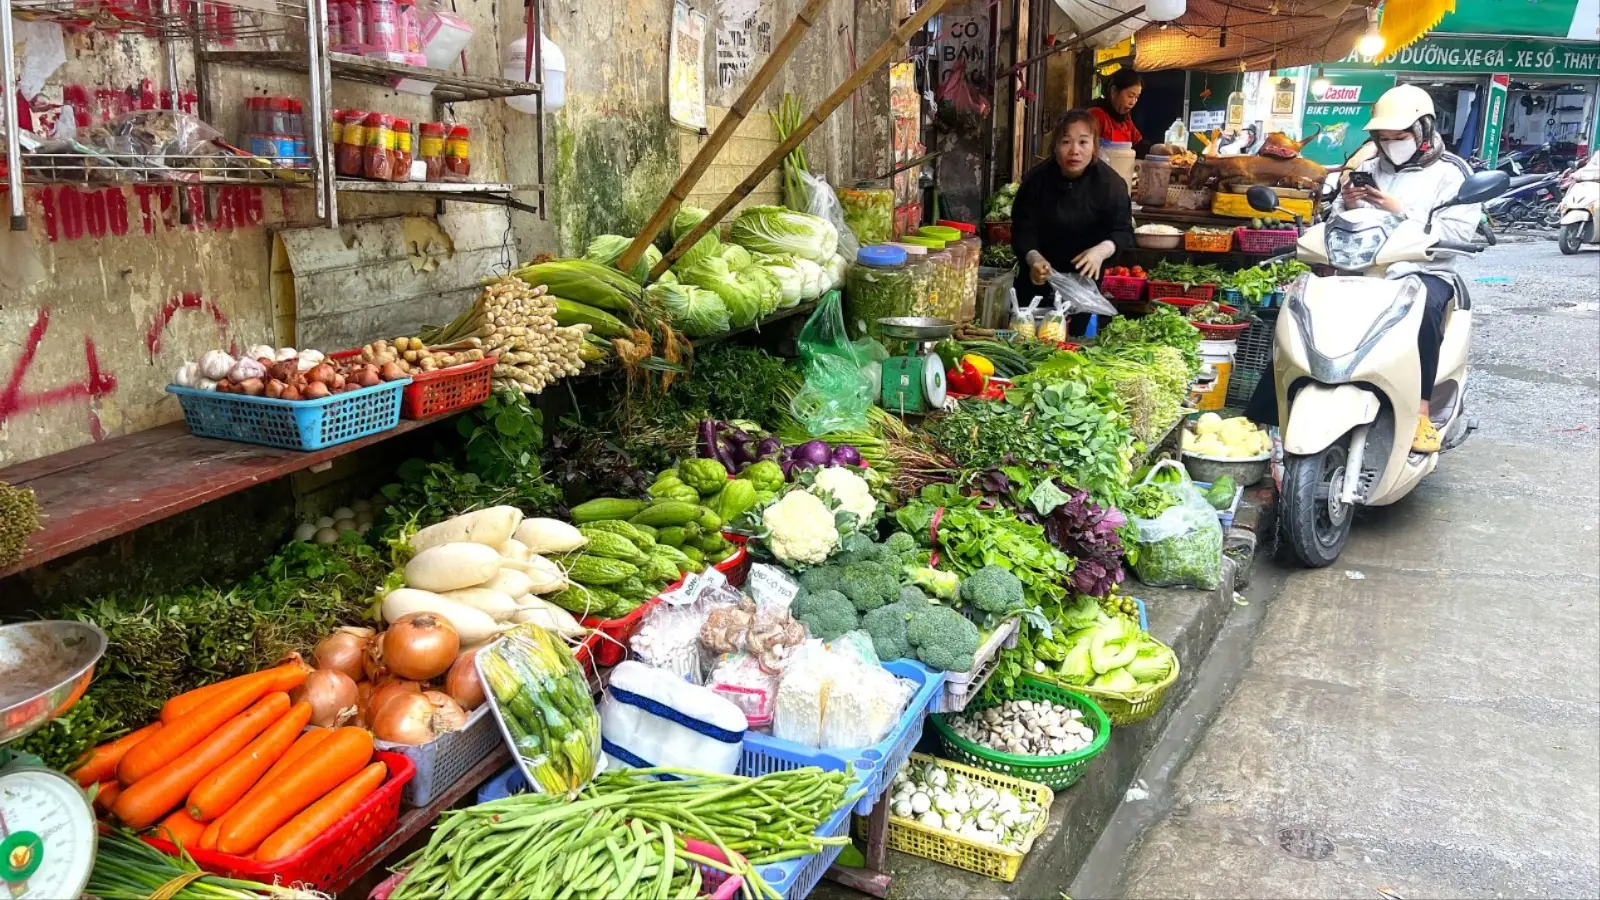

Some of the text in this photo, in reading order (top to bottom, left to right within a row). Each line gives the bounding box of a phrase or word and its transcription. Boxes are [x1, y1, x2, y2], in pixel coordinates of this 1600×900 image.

[951, 17, 979, 38] CÓ
[943, 41, 985, 61] BÁN
[1400, 43, 1460, 65] DƯỠNG
[1461, 48, 1482, 66] XE
[1484, 49, 1504, 66] GA
[1515, 50, 1533, 68] XE
[1535, 45, 1556, 68] SỐ
[1564, 52, 1596, 69] THAY
[1325, 87, 1359, 100] Castrol
[1306, 106, 1362, 115] BIKE POINT
